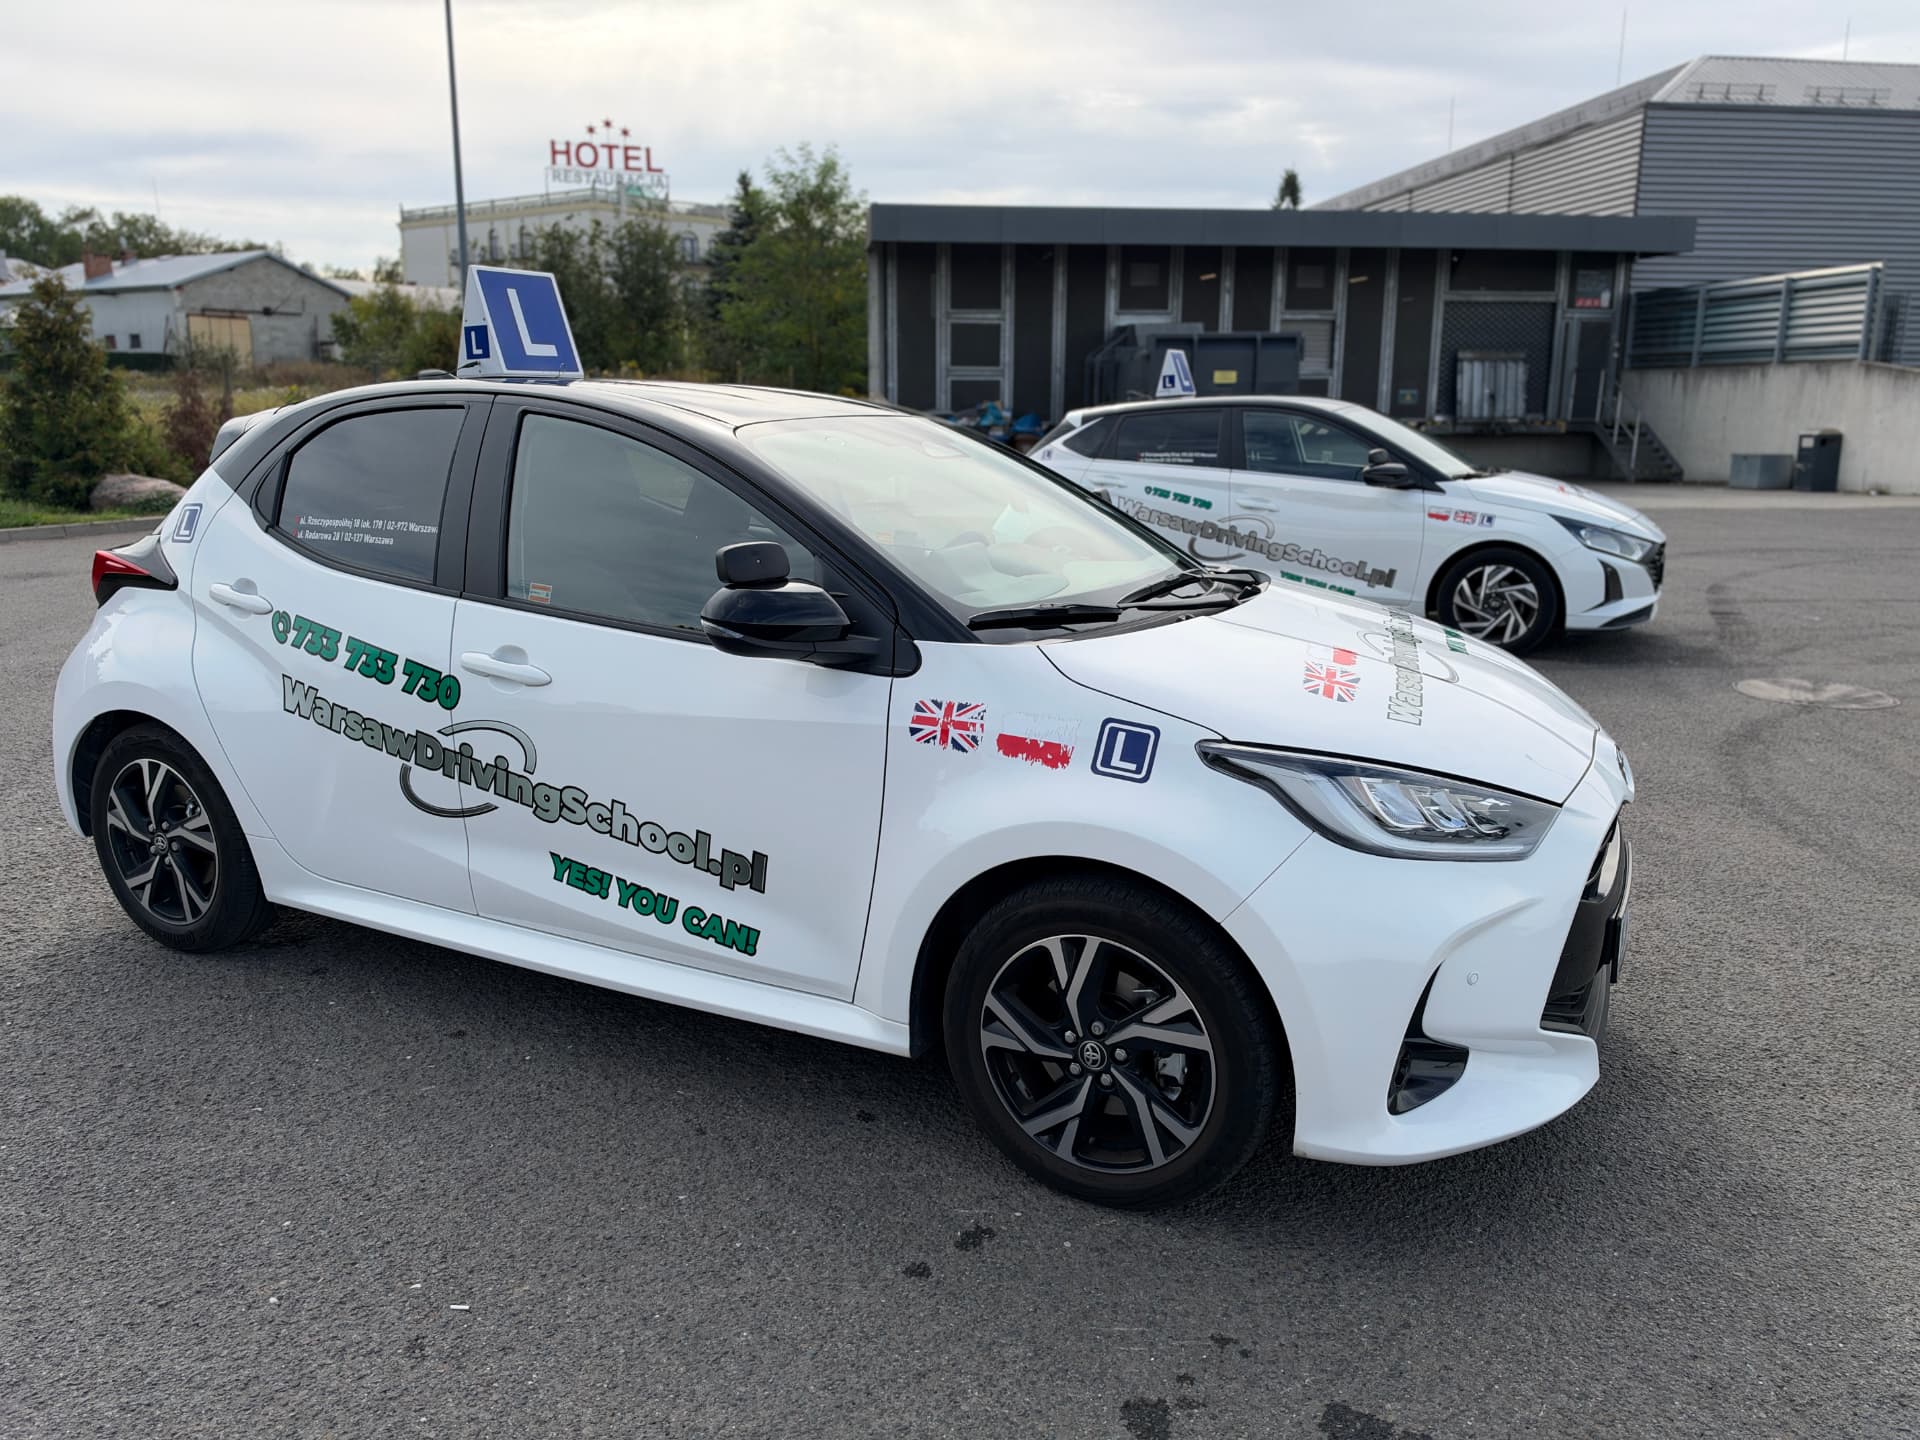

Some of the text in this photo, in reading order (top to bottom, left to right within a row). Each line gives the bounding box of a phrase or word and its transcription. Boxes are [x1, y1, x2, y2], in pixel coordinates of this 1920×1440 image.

[550, 140, 663, 172] HOTEL
[470, 330, 483, 355] L
[506, 288, 558, 357] L
[1165, 376, 1173, 388] L
[179, 510, 190, 535] L
[409, 521, 438, 534] Warszaw
[1118, 495, 1398, 589] WarsawDrivingSchool.pl
[292, 614, 461, 710] 733 733 730
[1110, 730, 1137, 771] L
[282, 674, 768, 893] WarsawDrivingSchool.pl
[549, 851, 761, 956] YES! YOU CAN!
